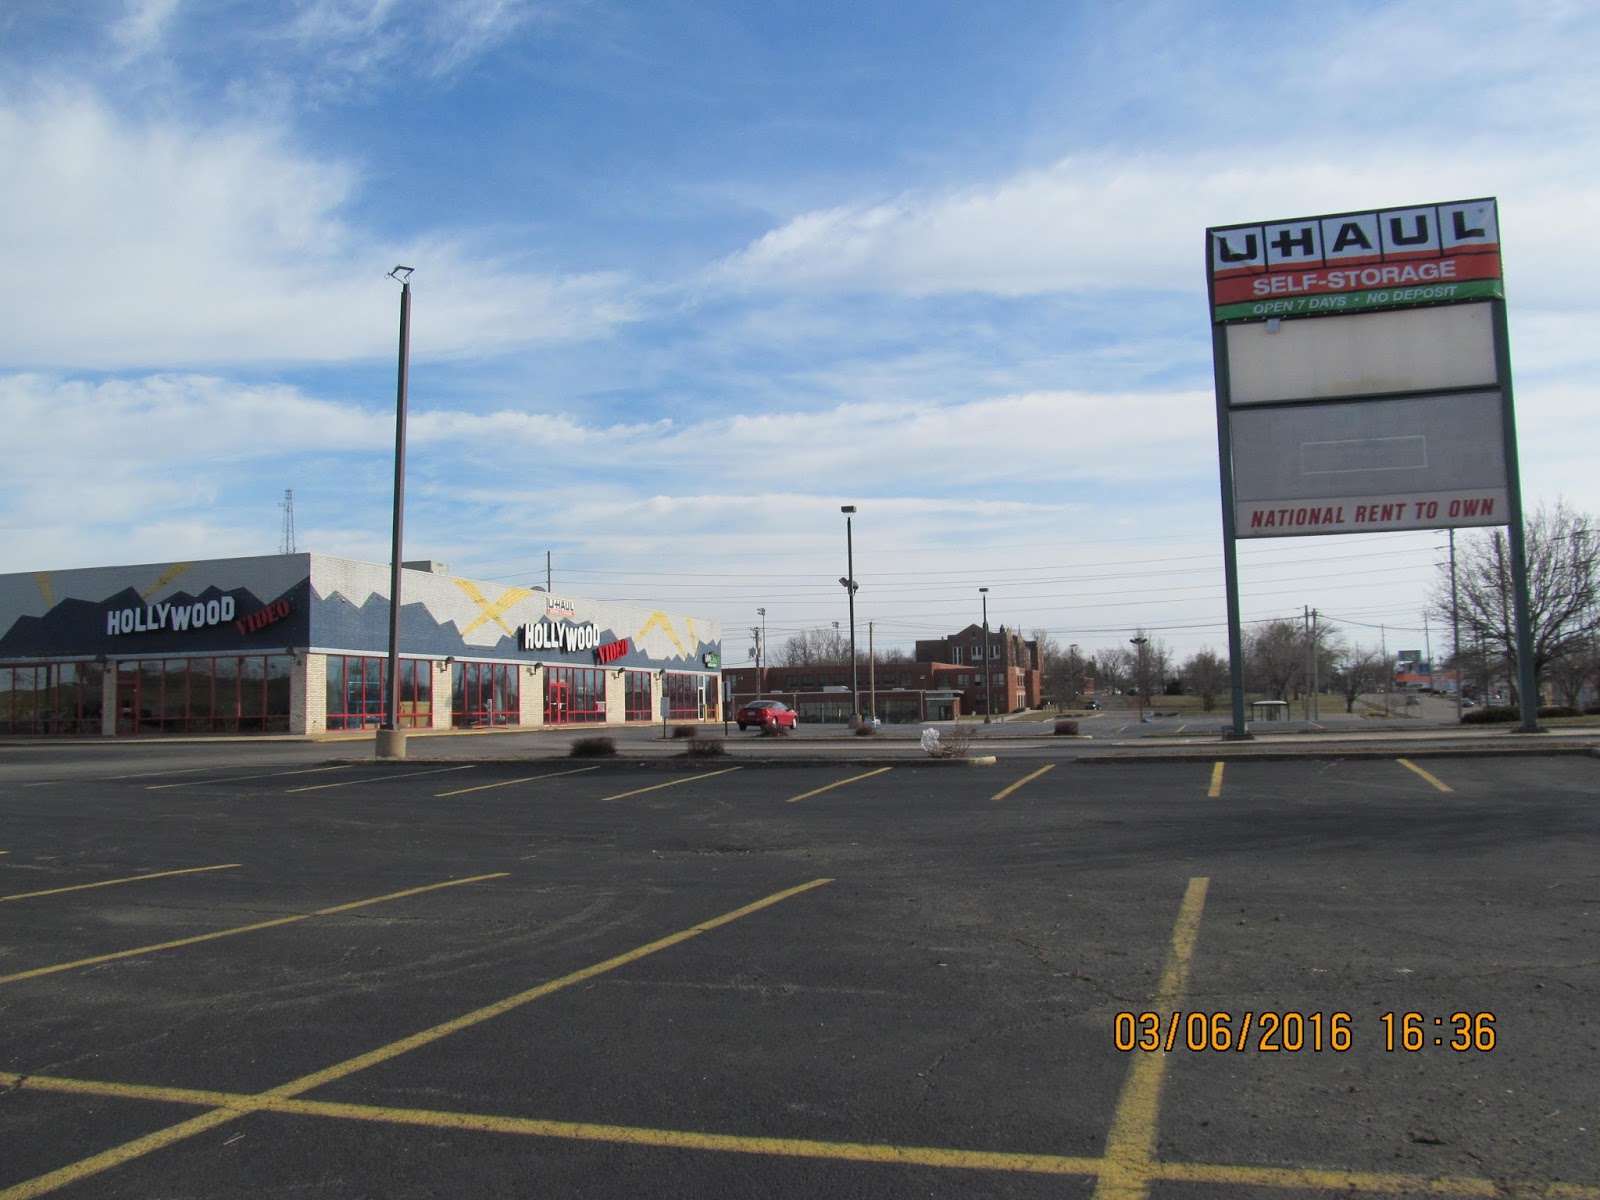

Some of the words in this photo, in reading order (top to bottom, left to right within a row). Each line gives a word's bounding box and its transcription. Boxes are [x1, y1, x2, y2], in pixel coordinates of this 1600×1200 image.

[1253, 260, 1456, 296] SELF-STORAGE
[1253, 300, 1293, 315] OPEN
[1298, 300, 1305, 310] 7
[1309, 296, 1347, 309] DAYS
[1366, 292, 1389, 304] NO
[1393, 285, 1458, 301] DEPOSIT
[1251, 506, 1345, 528] NATIONAL
[1355, 503, 1407, 523] RENT
[1415, 501, 1438, 520] TO
[1448, 498, 1495, 517] OWN
[107, 596, 235, 635] HOLLYWOOD
[236, 599, 291, 636] VIDEO
[524, 622, 600, 652] HOLLYWOOD
[598, 638, 629, 665] VIDEO
